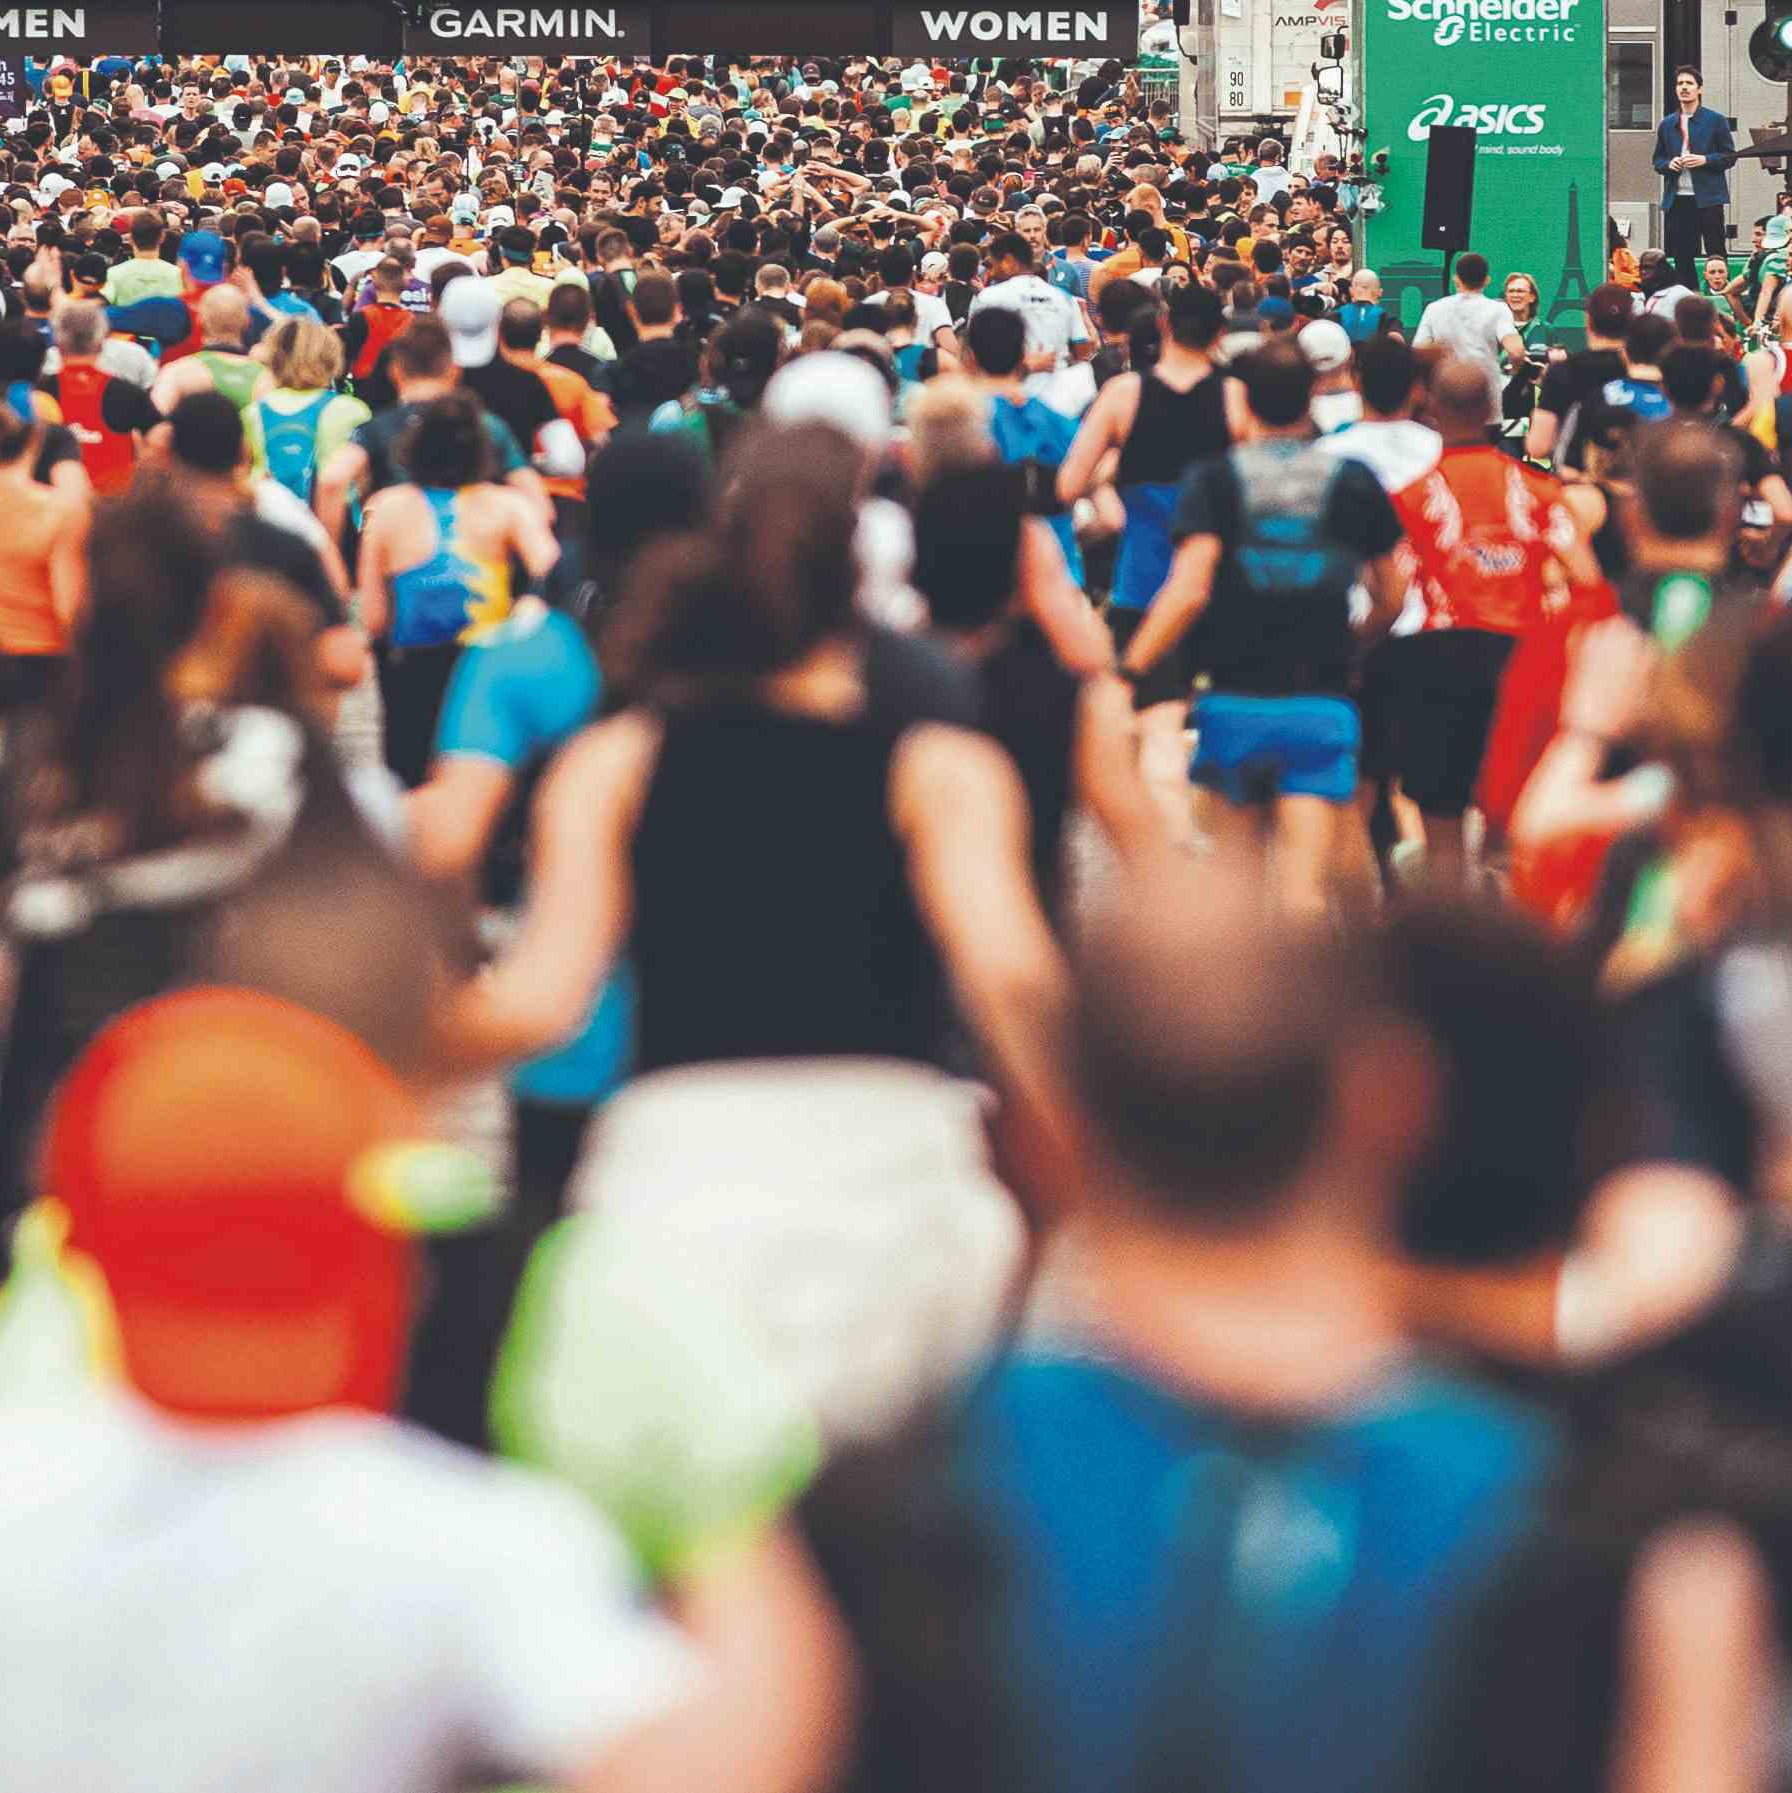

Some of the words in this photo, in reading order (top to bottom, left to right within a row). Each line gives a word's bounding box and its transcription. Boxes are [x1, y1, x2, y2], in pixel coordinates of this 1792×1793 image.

[920, 11, 1107, 41] WOMEN
[1275, 15, 1346, 26] AMPVIS
[1470, 22, 1575, 42] Electric
[1230, 71, 1244, 87] 90
[1229, 91, 1244, 107] 80
[1478, 144, 1504, 155] mind,
[1507, 144, 1536, 155] sound
[1538, 144, 1565, 157] body
